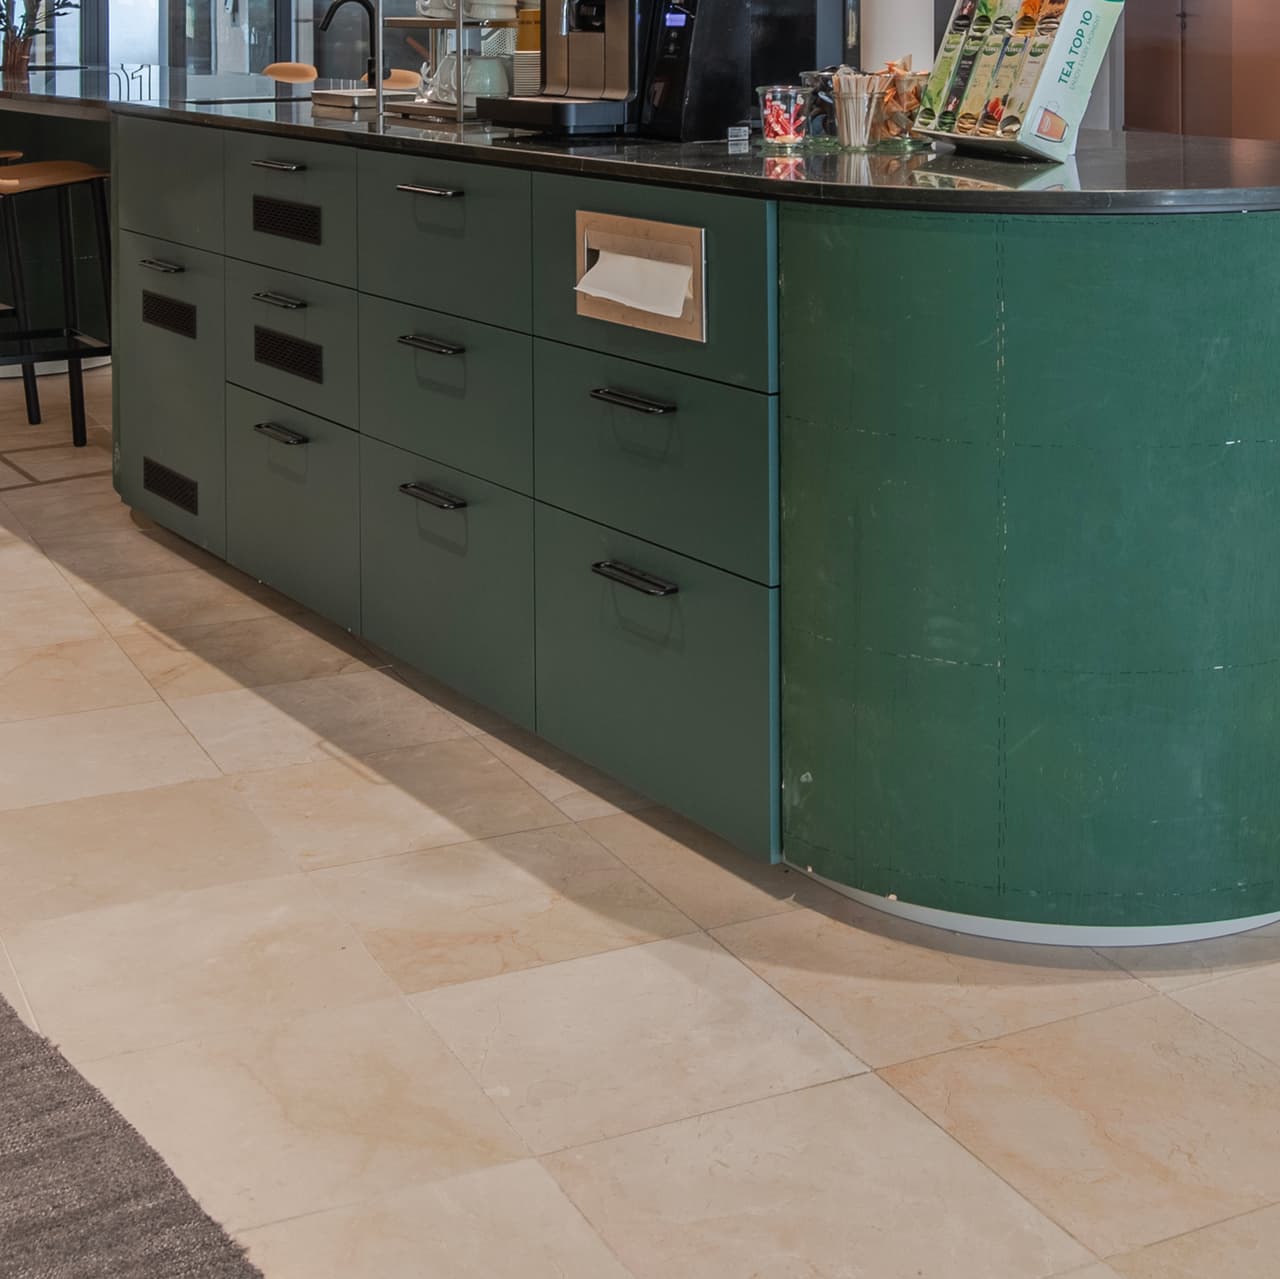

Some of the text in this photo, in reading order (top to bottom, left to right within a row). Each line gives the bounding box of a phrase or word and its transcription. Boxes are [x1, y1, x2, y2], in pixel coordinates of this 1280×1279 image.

[1058, 10, 1093, 84] TEA TOP 10
